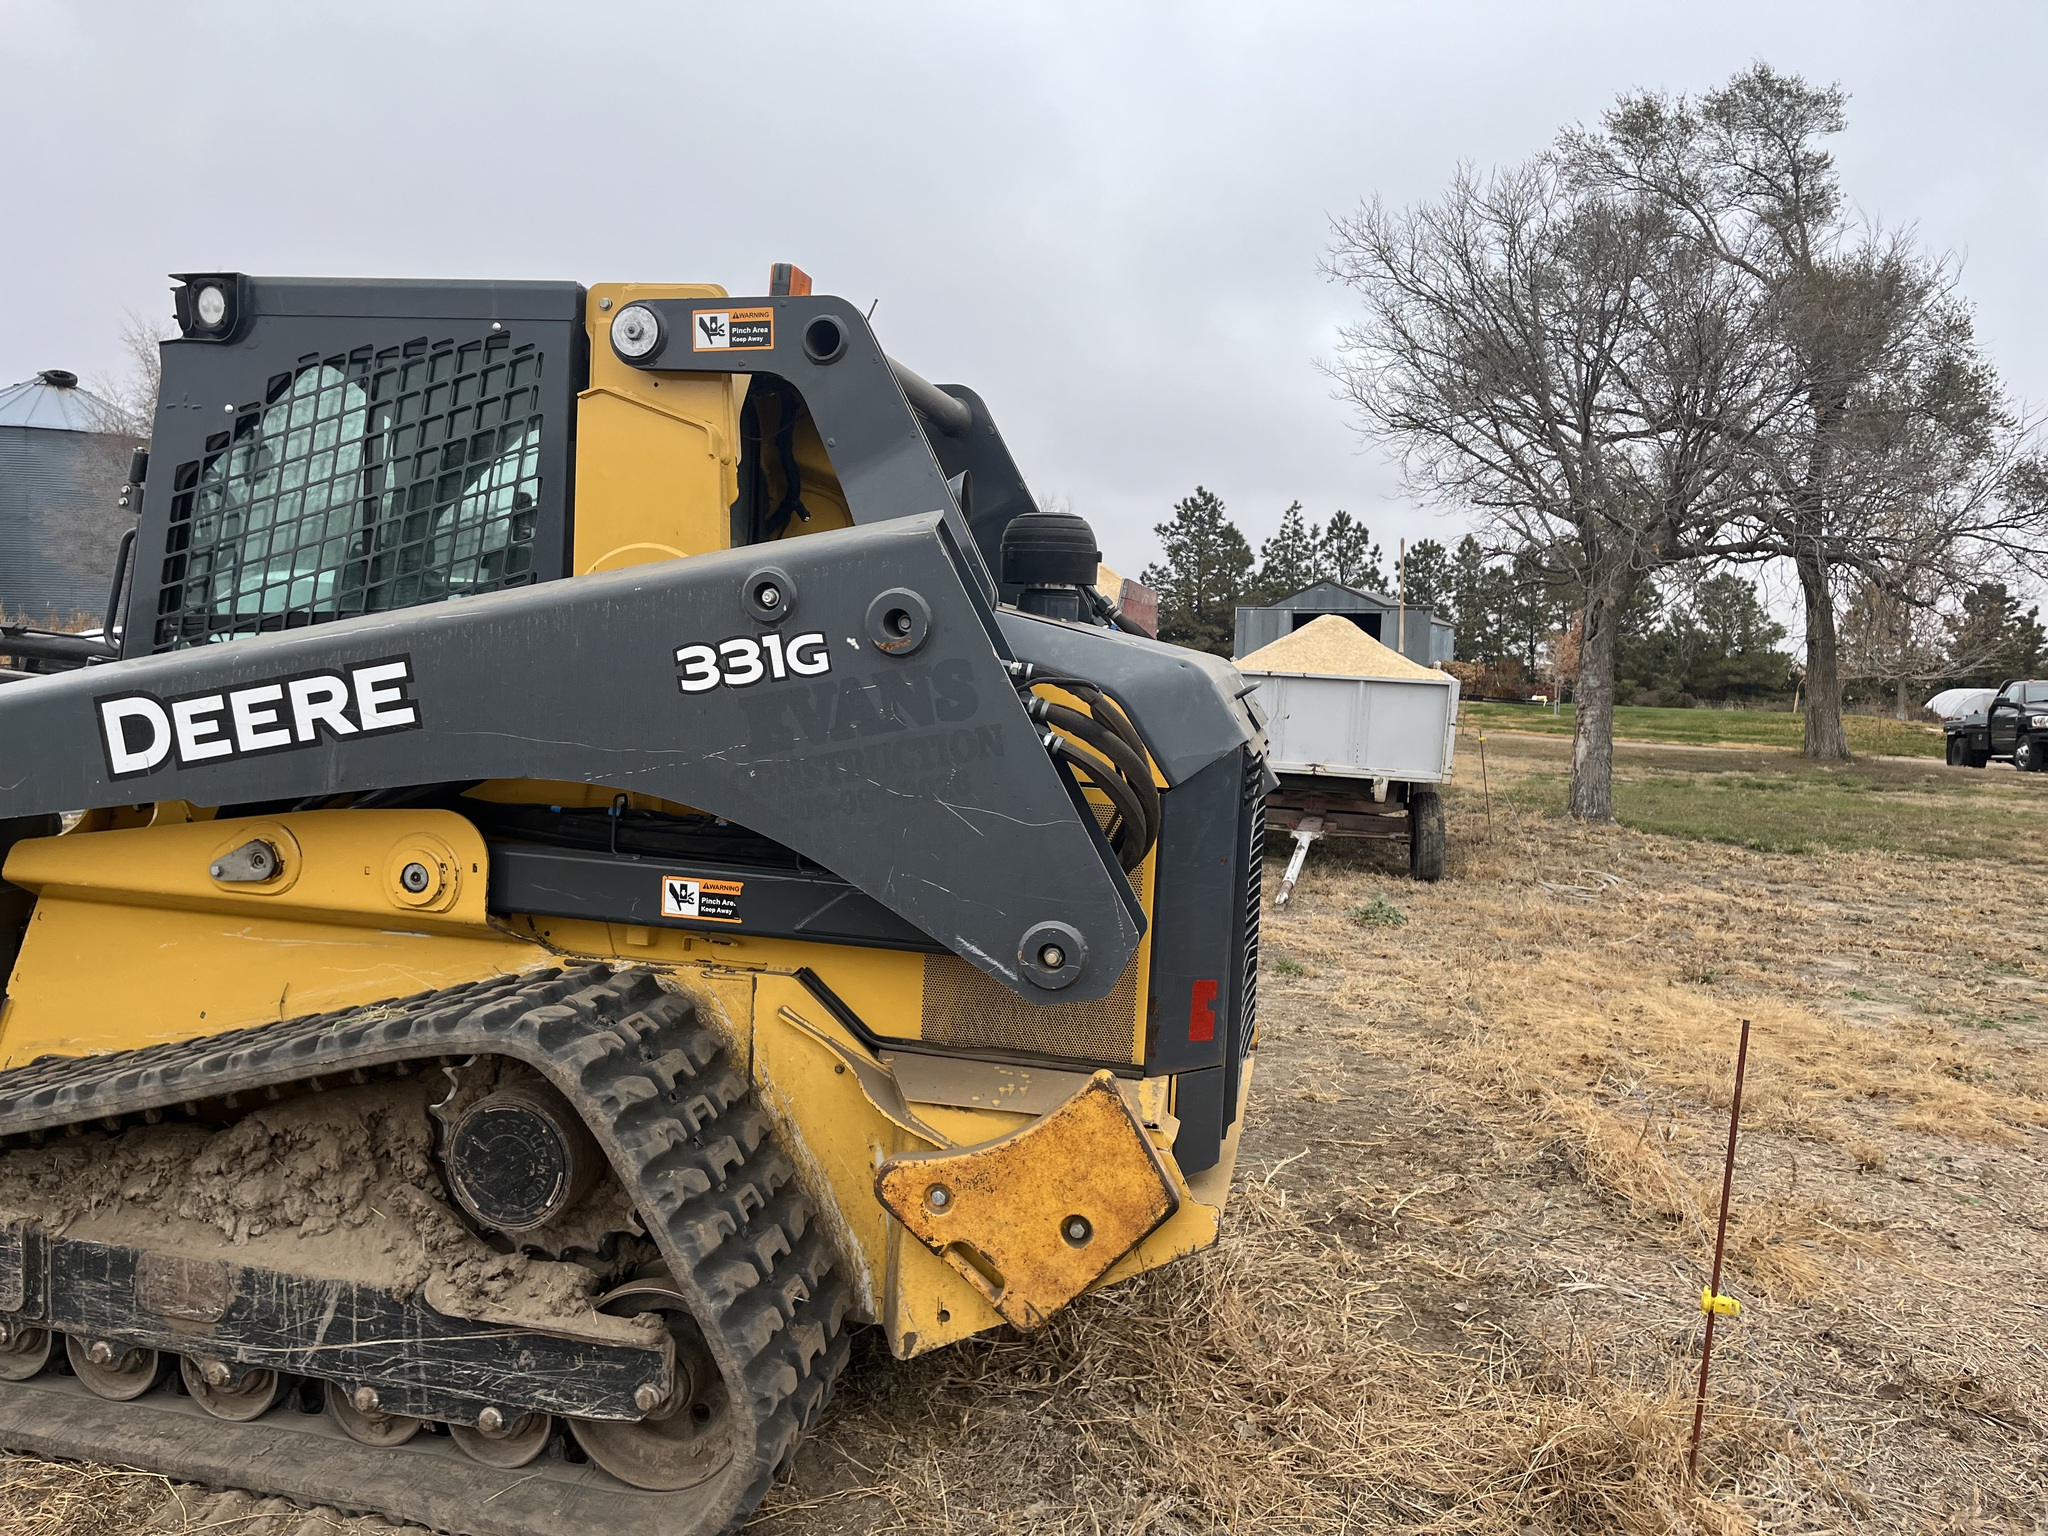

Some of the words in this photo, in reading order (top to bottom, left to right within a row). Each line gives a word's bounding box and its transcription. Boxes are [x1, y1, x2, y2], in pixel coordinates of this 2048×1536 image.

[739, 311, 770, 319] WARNING
[752, 326, 769, 334] Area
[747, 335, 764, 343] Away
[675, 633, 831, 693] 331G
[737, 657, 980, 757] EVANS
[101, 661, 416, 775] DEERE
[709, 883, 740, 892] WARNING
[701, 896, 721, 905] Pinch
[700, 905, 715, 914] Keep
[716, 907, 733, 916] Away
